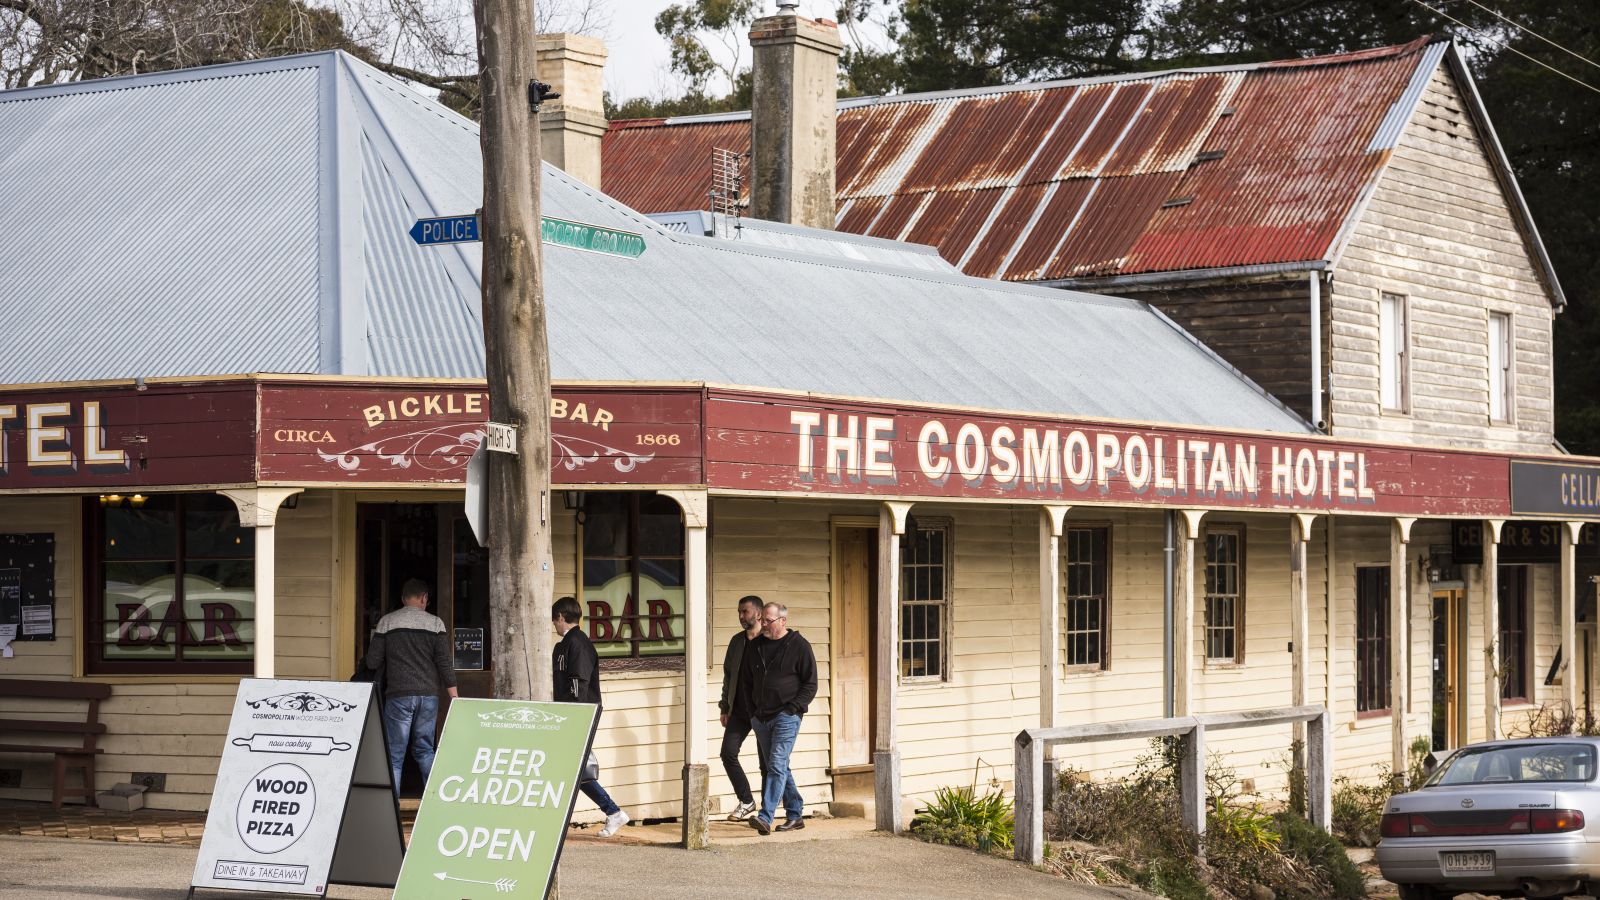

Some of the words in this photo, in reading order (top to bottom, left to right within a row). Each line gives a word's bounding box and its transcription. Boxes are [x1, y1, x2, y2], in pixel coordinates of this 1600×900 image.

[423, 219, 473, 242] POLICE
[541, 221, 588, 247] SPORTS
[592, 230, 642, 257] GROUND
[363, 393, 490, 429] BICKLE
[551, 398, 615, 432] BAR
[274, 429, 336, 443] CIRCA
[488, 425, 504, 448] HIGH
[635, 434, 681, 446] 1866
[790, 411, 895, 478] THE
[917, 420, 1256, 494] COSMOPOLITAN
[1271, 446, 1374, 499] HOTEL
[1521, 527, 1533, 545] &
[115, 594, 246, 649] BAR
[587, 593, 675, 645] BAR
[269, 739, 284, 747] now
[285, 739, 312, 750] cooking
[471, 747, 546, 777] BEER
[255, 778, 308, 795] WOOD
[438, 775, 565, 809] GARDEN
[251, 800, 300, 816] FIRED
[246, 820, 295, 837] PIZZA
[437, 825, 536, 862] OPEN
[217, 864, 237, 876] DINE
[239, 866, 249, 876] IN
[249, 866, 256, 877] &
[258, 867, 306, 880] TAKEAWAY
